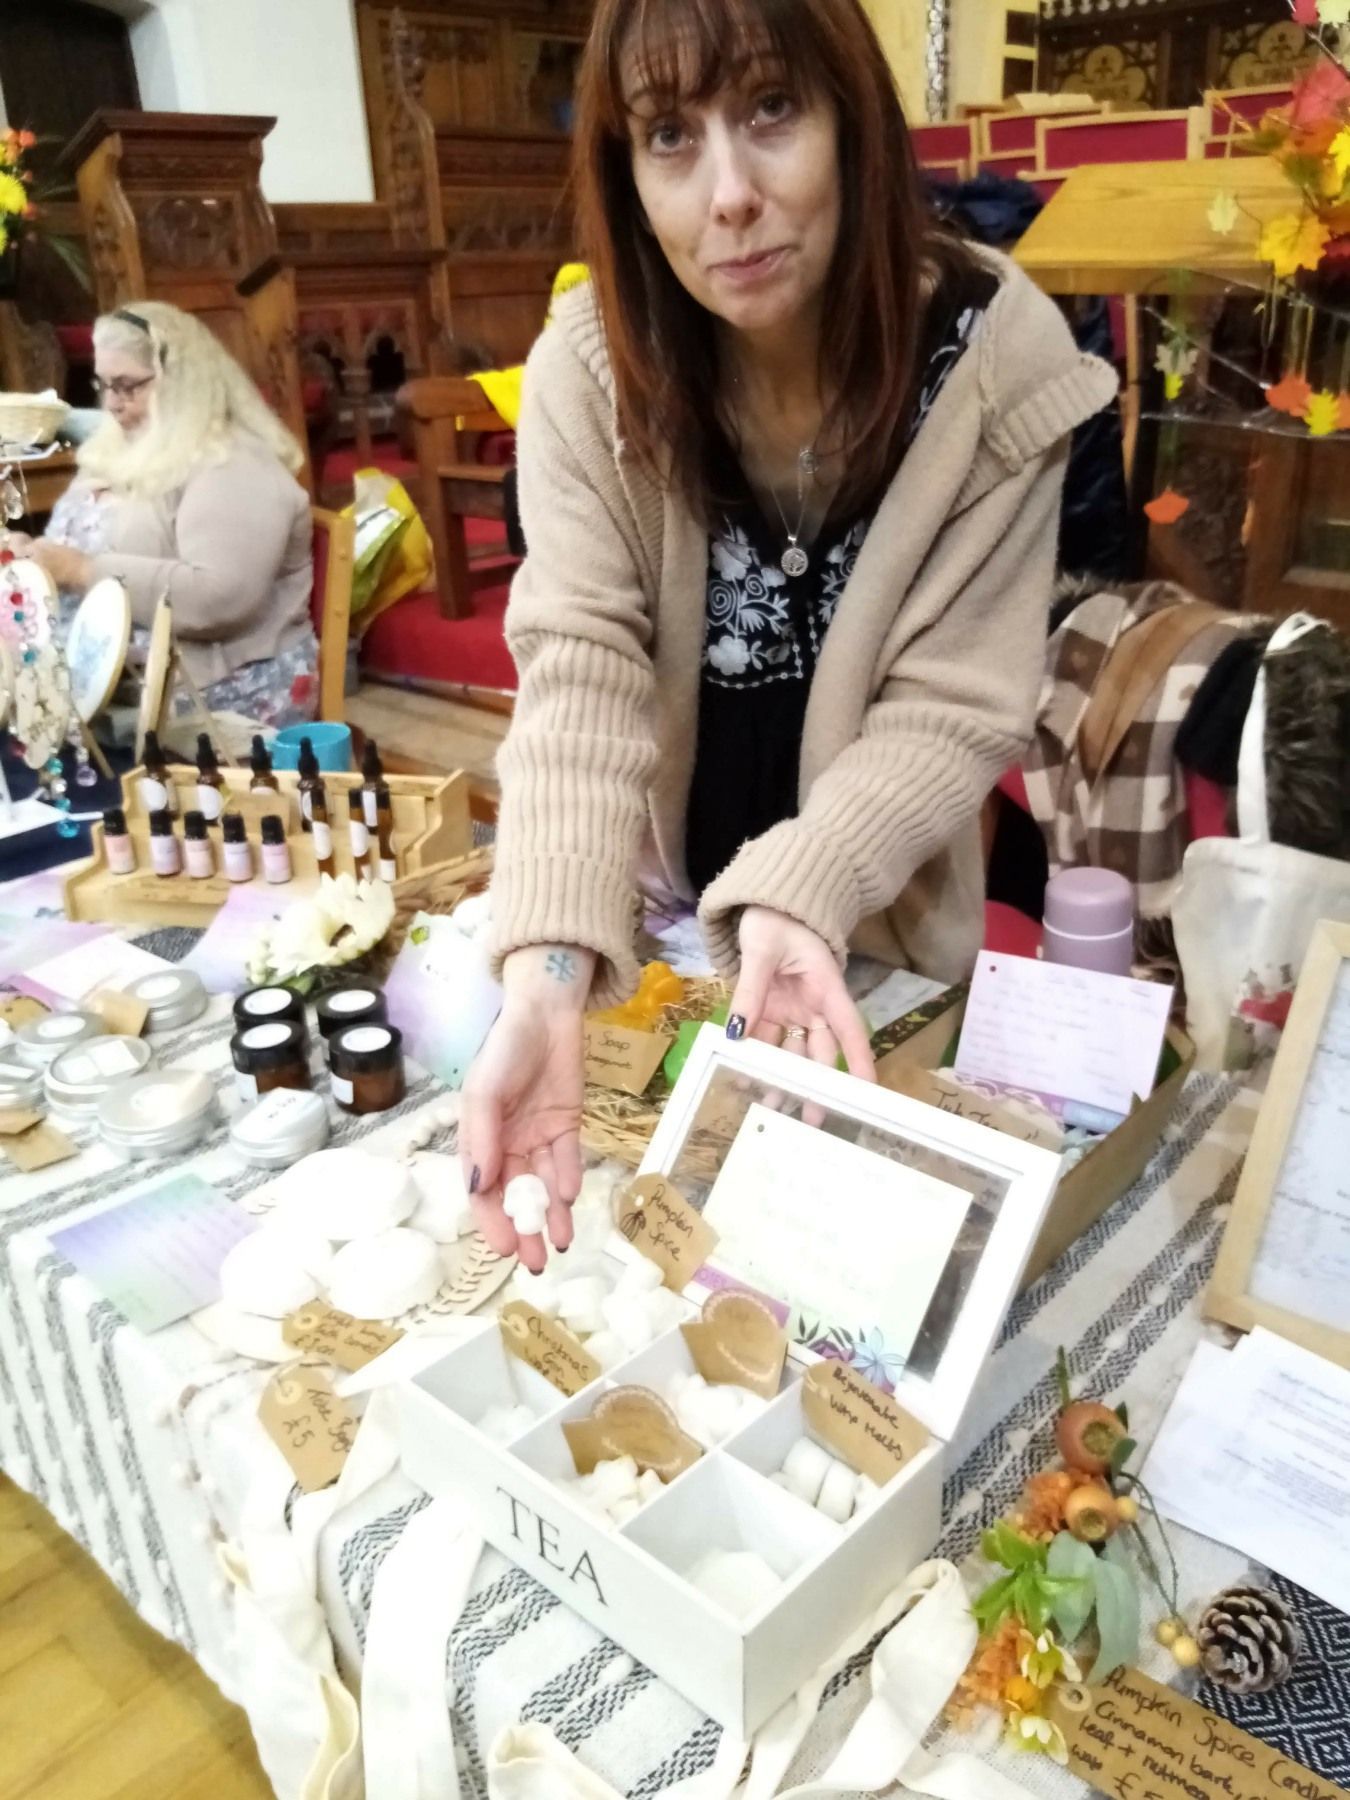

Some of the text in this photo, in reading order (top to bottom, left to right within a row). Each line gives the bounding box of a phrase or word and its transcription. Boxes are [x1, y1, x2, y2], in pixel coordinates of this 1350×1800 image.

[597, 1030, 631, 1053] Soap
[648, 1221, 681, 1262] Spice
[496, 1486, 610, 1608] TEA
[1094, 1699, 1185, 1765] Cinnamon
[1102, 1663, 1183, 1728] Pumpkin
[1193, 1715, 1257, 1768] Spice
